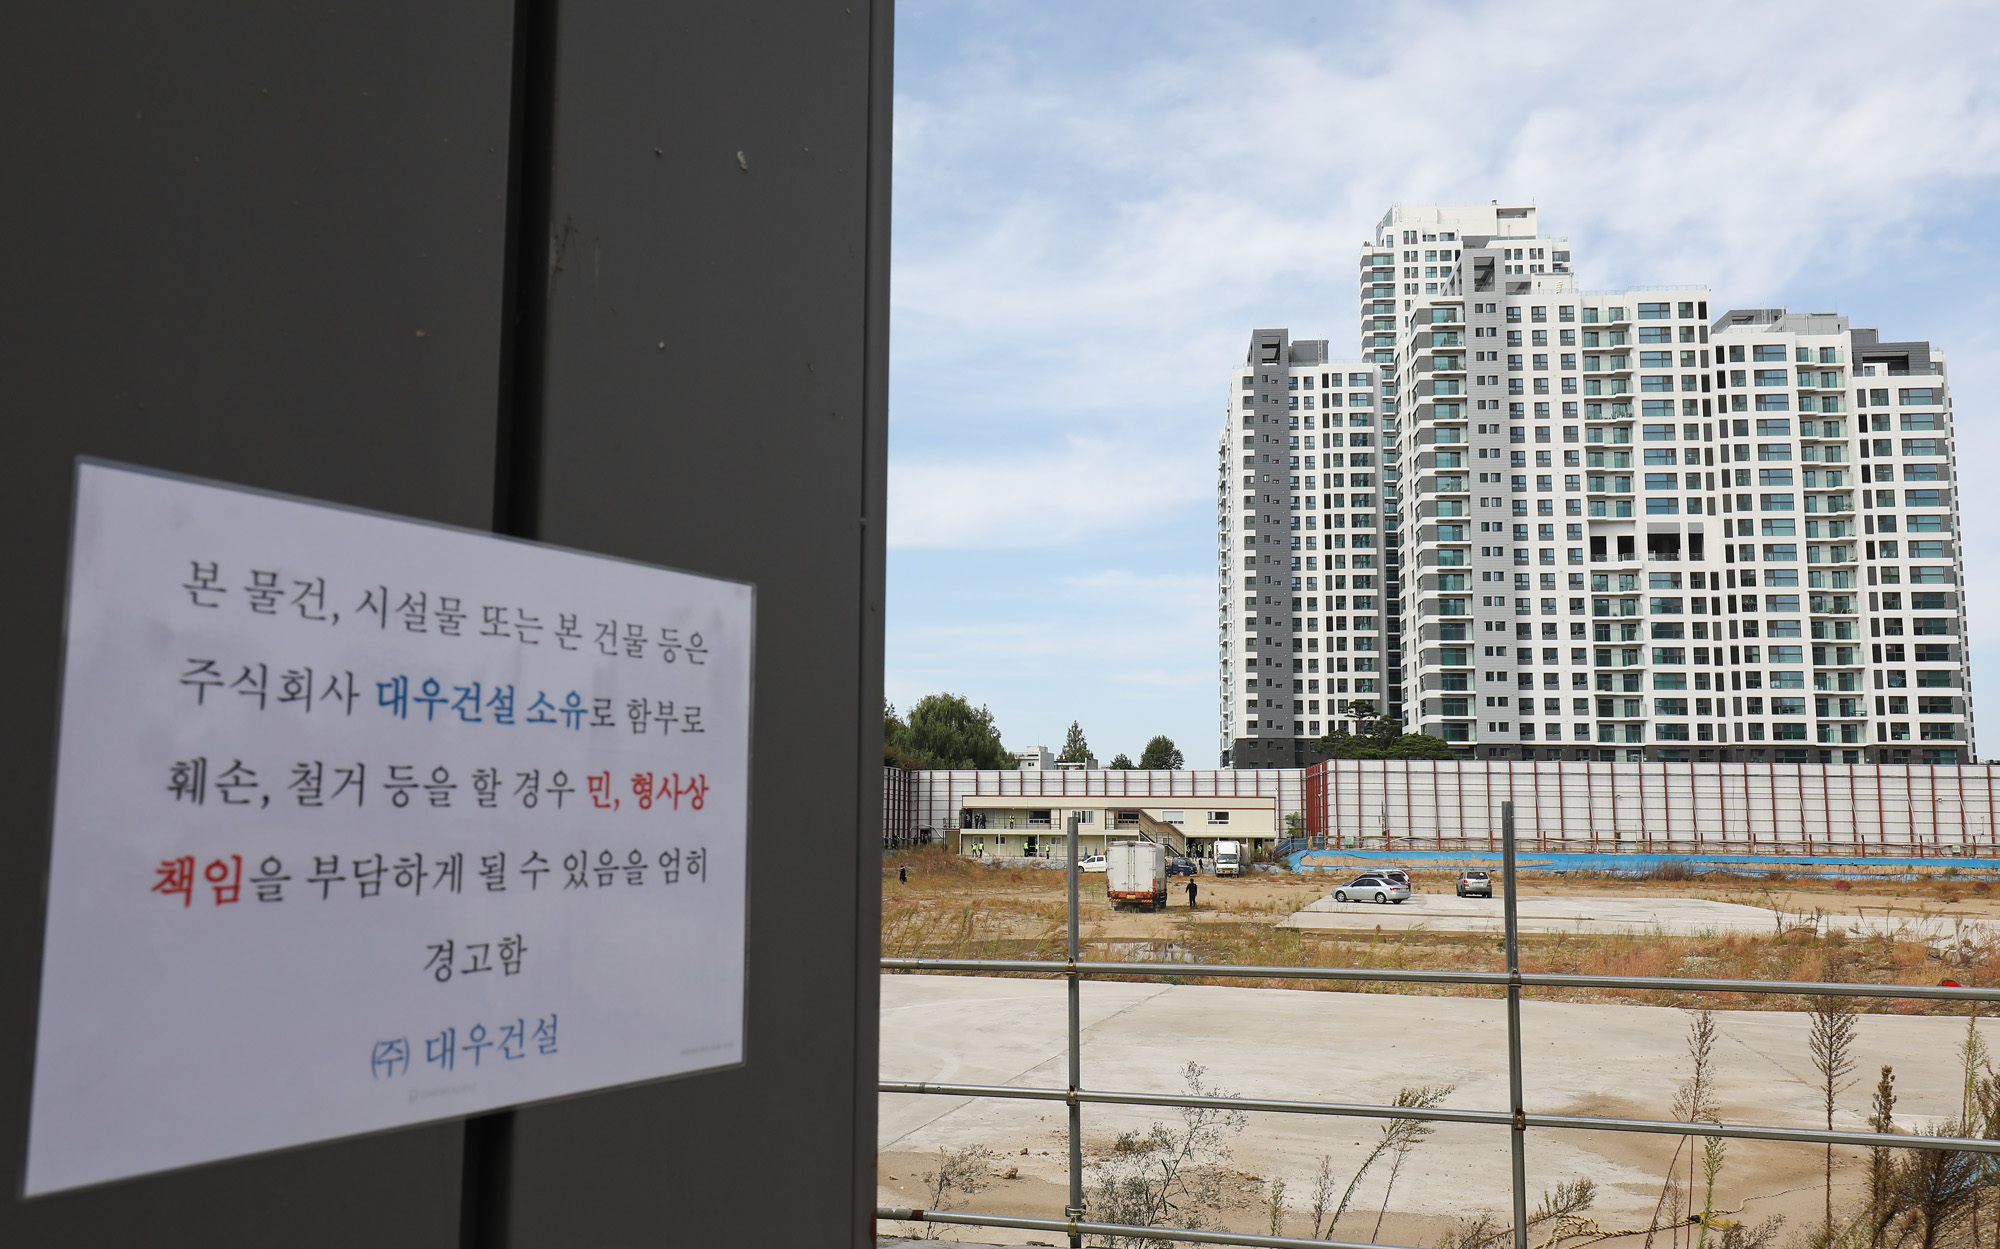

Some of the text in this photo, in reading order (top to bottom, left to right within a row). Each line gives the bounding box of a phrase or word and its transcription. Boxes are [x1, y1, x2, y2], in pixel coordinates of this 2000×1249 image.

[183, 561, 708, 665] 본 물건, 시설물 또는 본 건물 등은
[180, 659, 705, 735] 주식회사 대우건설 소유로 함부로
[167, 757, 710, 811] 훼손, 철거 등을 할 경우 민, 형사상
[151, 847, 706, 908] 책임을 부담하게 될 수 있음을 엄히
[425, 934, 527, 983] 경고함
[426, 1014, 558, 1070] 대우건설
